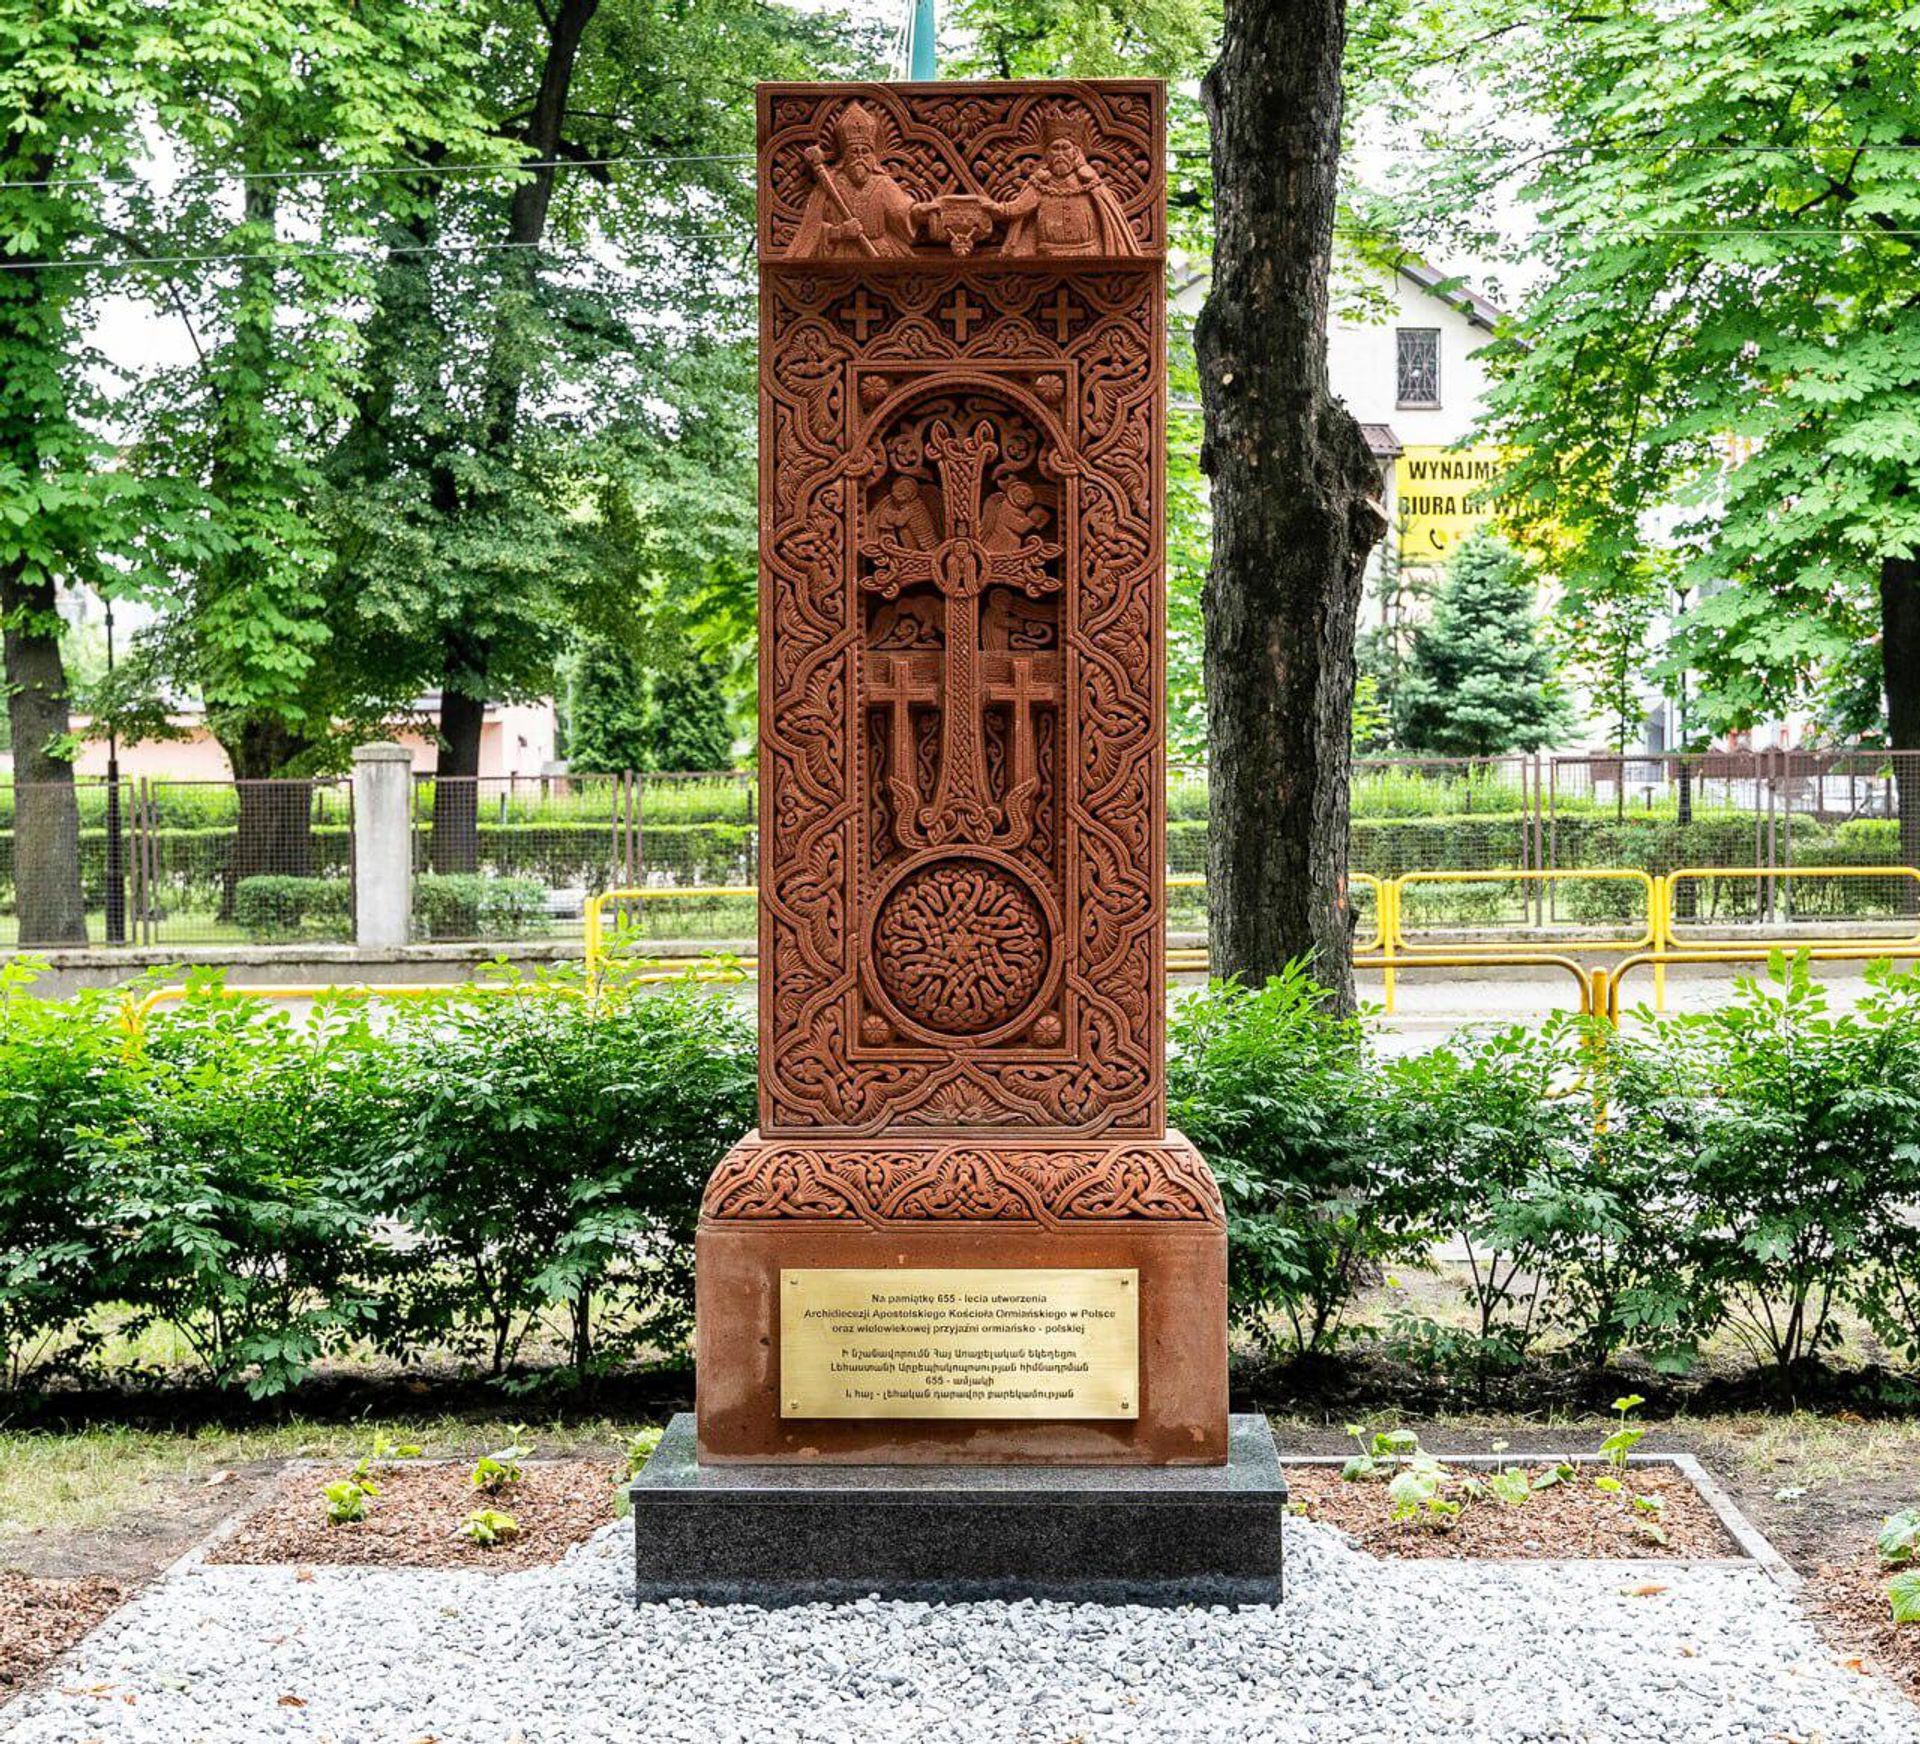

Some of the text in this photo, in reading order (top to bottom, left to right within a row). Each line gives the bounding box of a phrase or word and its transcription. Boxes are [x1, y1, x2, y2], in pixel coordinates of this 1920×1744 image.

[871, 1293, 886, 1303] Na
[887, 1293, 935, 1305] pamiątkę
[937, 1293, 956, 1303] 655
[964, 1293, 989, 1303] lecia
[991, 1294, 1047, 1303] utworzenia
[803, 1308, 1116, 1320] Archidiecezji Apostolskiego Kościoła Ormiańskiego w Polsce
[831, 1325, 855, 1333] oraz
[856, 1323, 931, 1335] wielowiekowej
[932, 1323, 980, 1335] przyjaźni
[981, 1323, 1037, 1333] ormiańsko
[1044, 1323, 1086, 1335] polskiej
[925, 1376, 944, 1386] 655
